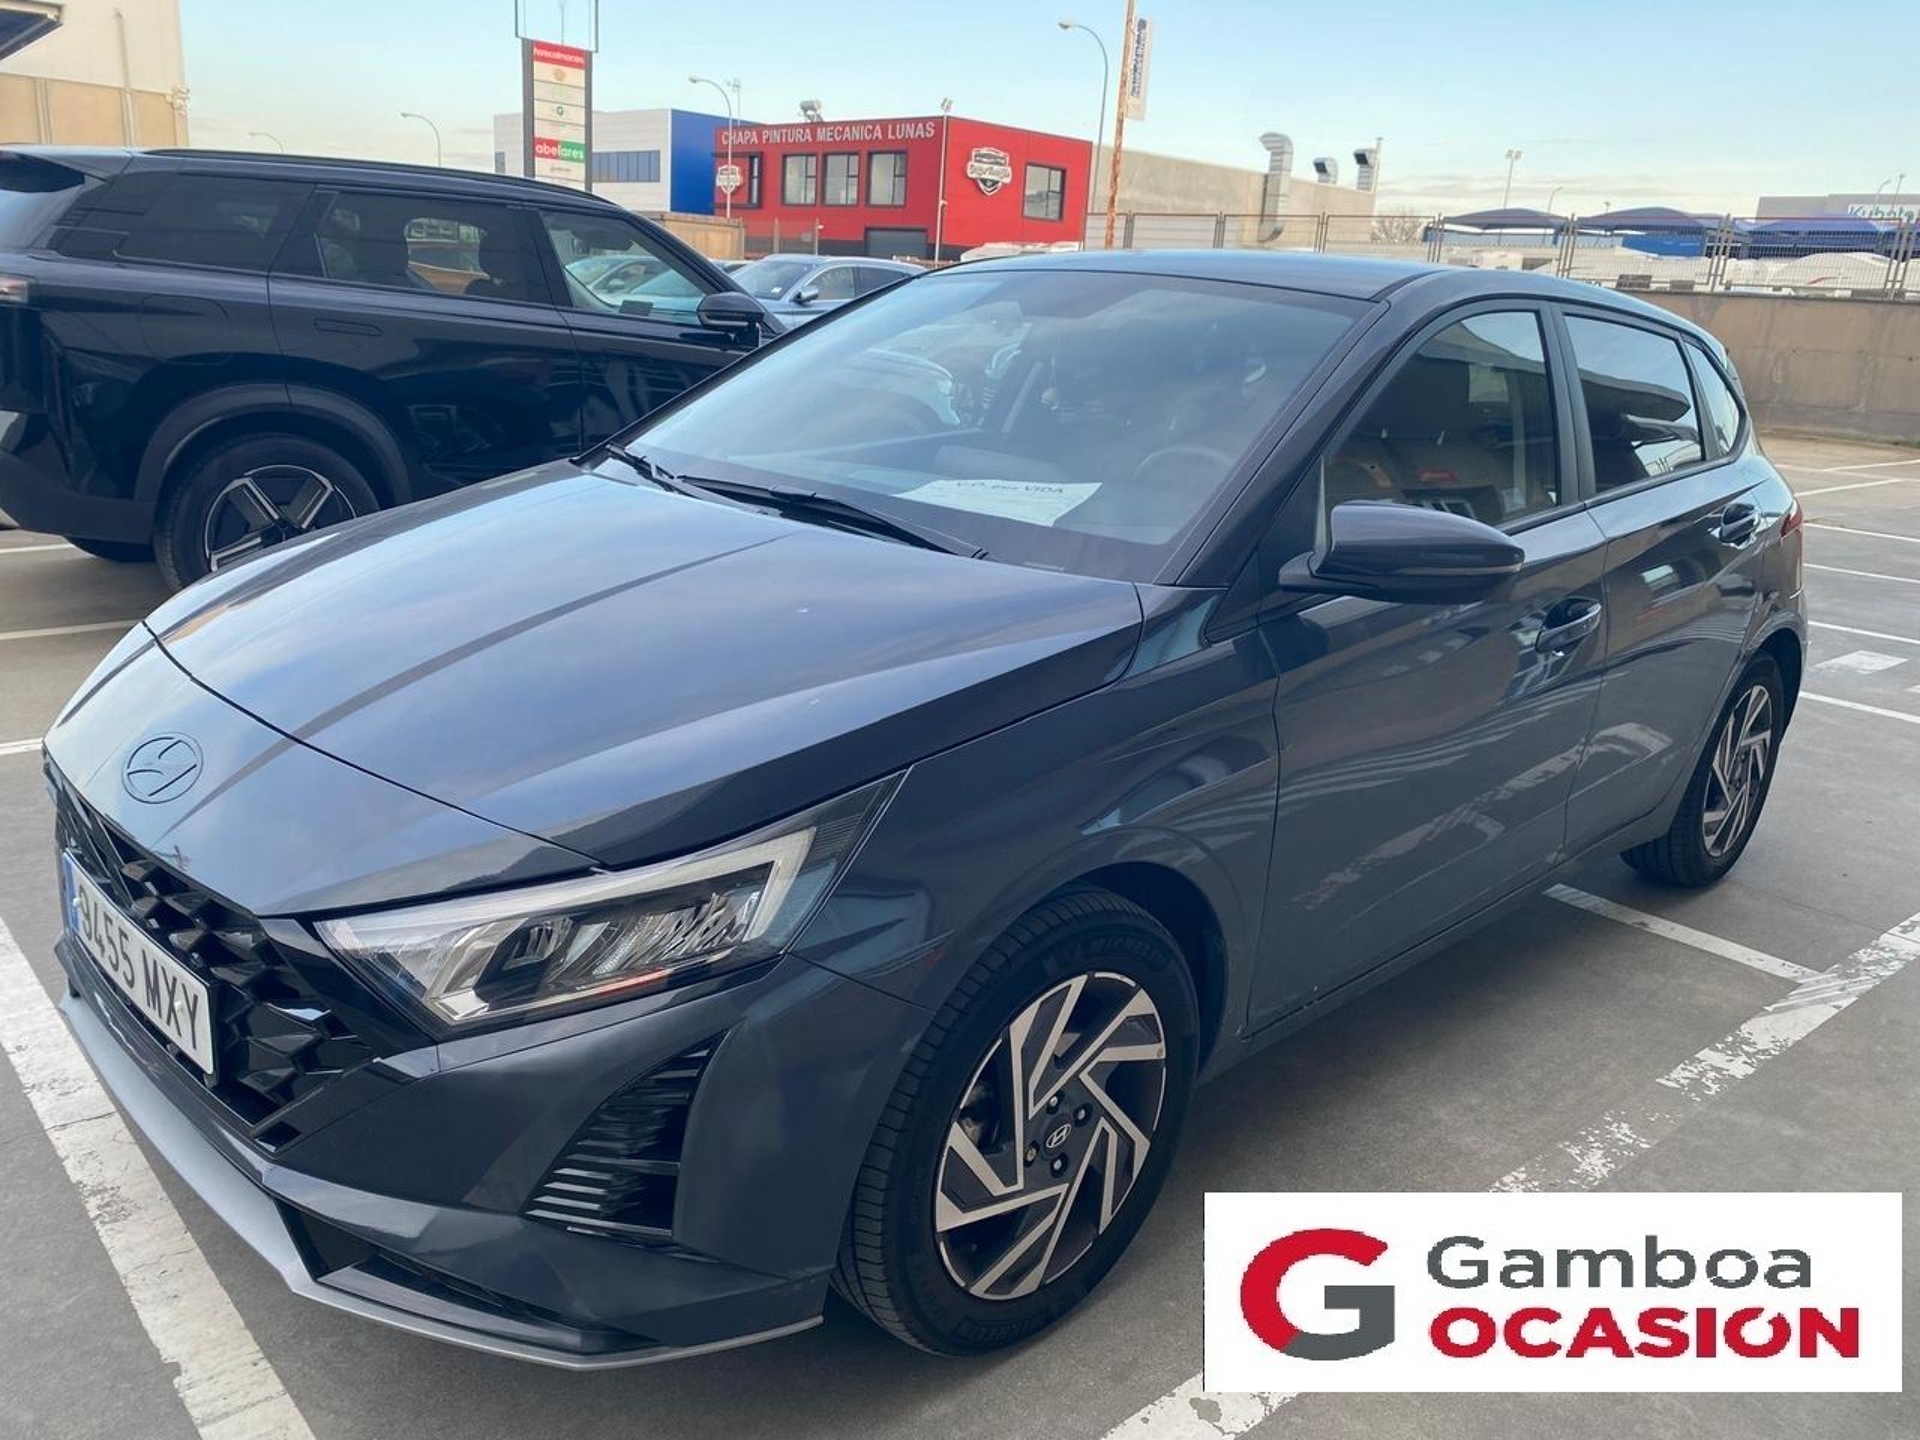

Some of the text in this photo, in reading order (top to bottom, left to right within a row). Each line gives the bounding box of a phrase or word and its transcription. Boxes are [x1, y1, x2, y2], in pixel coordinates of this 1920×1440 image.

[721, 121, 935, 146] CHAPA PINTURA MECANICA LUNAS
[78, 884, 199, 1051] 9455 MXY
